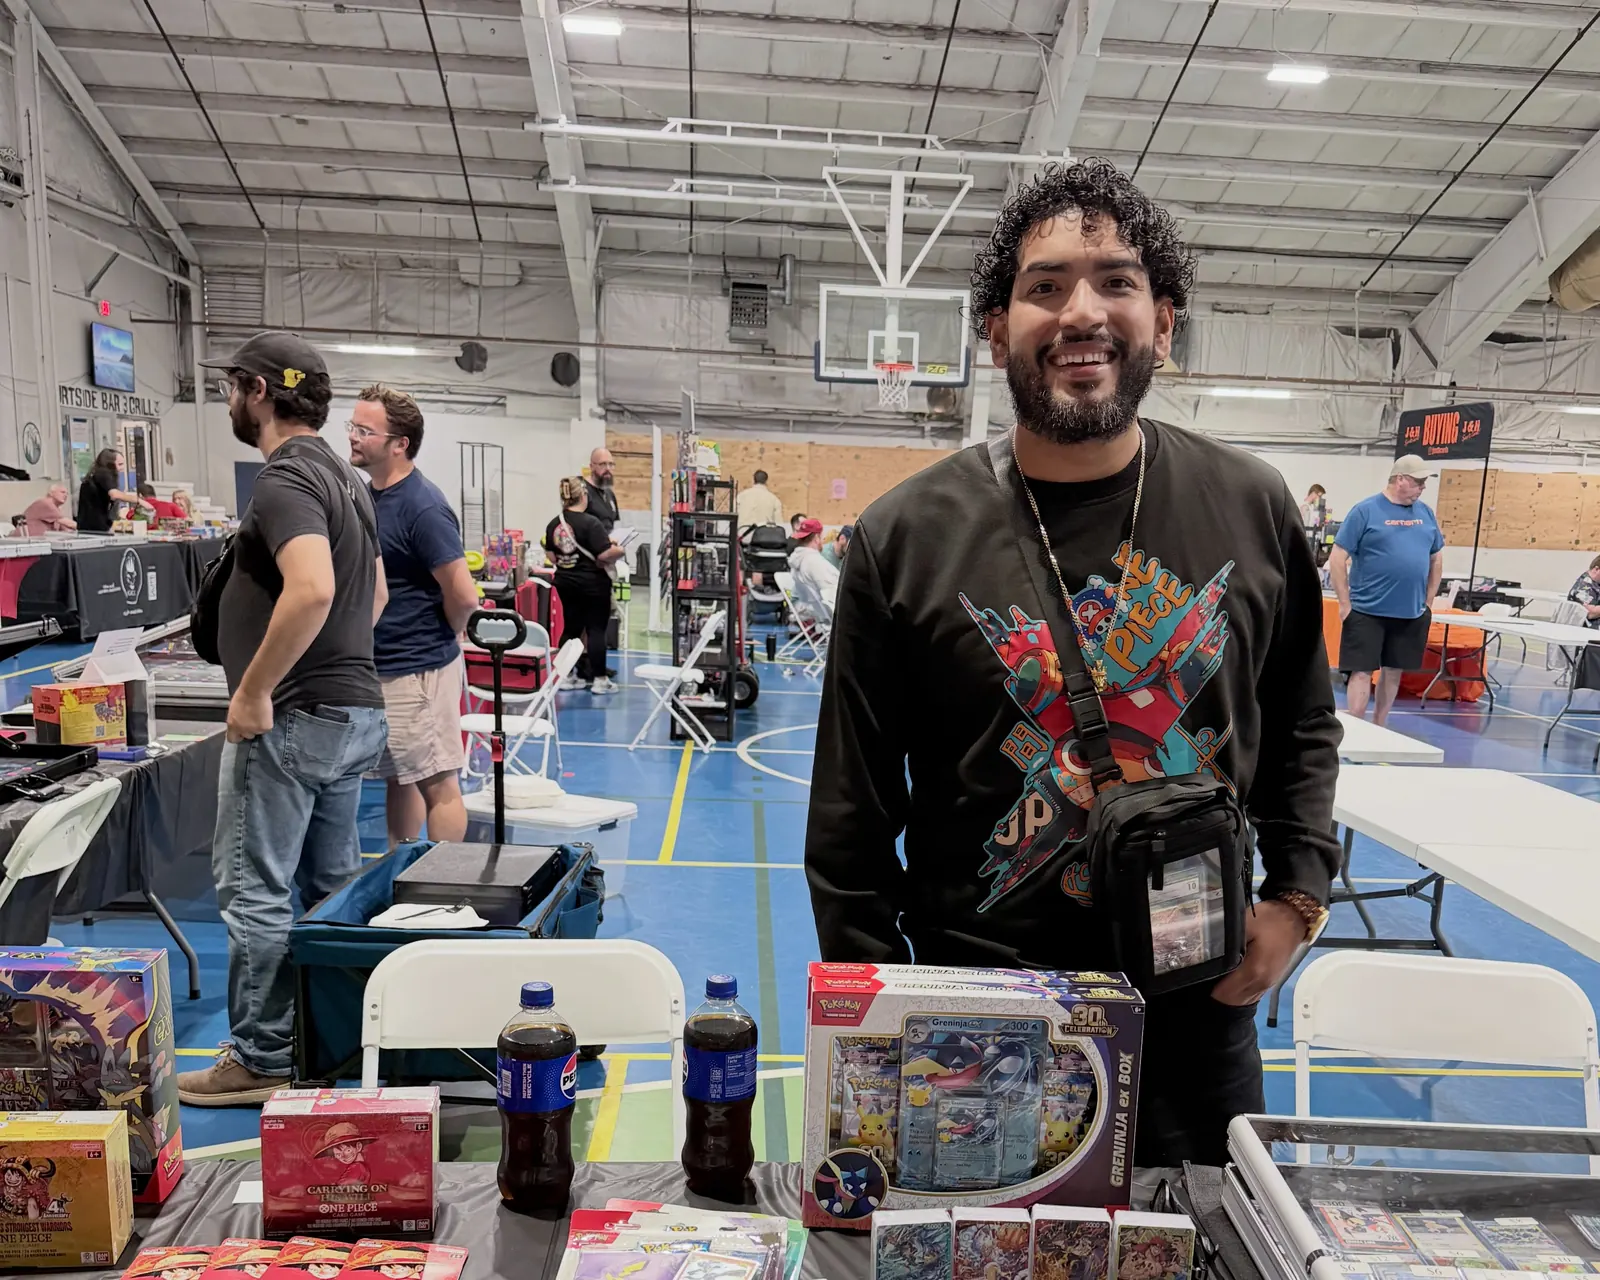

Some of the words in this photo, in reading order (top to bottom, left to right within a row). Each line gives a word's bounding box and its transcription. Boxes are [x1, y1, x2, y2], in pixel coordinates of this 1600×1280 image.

[59, 385, 98, 409] RTSIDE
[102, 391, 120, 413] BAR
[129, 396, 154, 417] GRILL
[1422, 411, 1461, 446] BUYING
[1103, 571, 1194, 674] PIECE
[932, 1018, 967, 1030] Greninja
[1010, 1021, 1029, 1031] 300
[1063, 1026, 1114, 1035] CELEBRATION
[1117, 1051, 1135, 1086] BOX
[1110, 1112, 1130, 1188] GRENINJA
[1016, 1153, 1028, 1161] 160
[307, 1184, 368, 1195] CARRYING
[371, 1183, 388, 1193] ON
[347, 1202, 378, 1213] PIECE
[19, 1233, 53, 1243] PIECE
